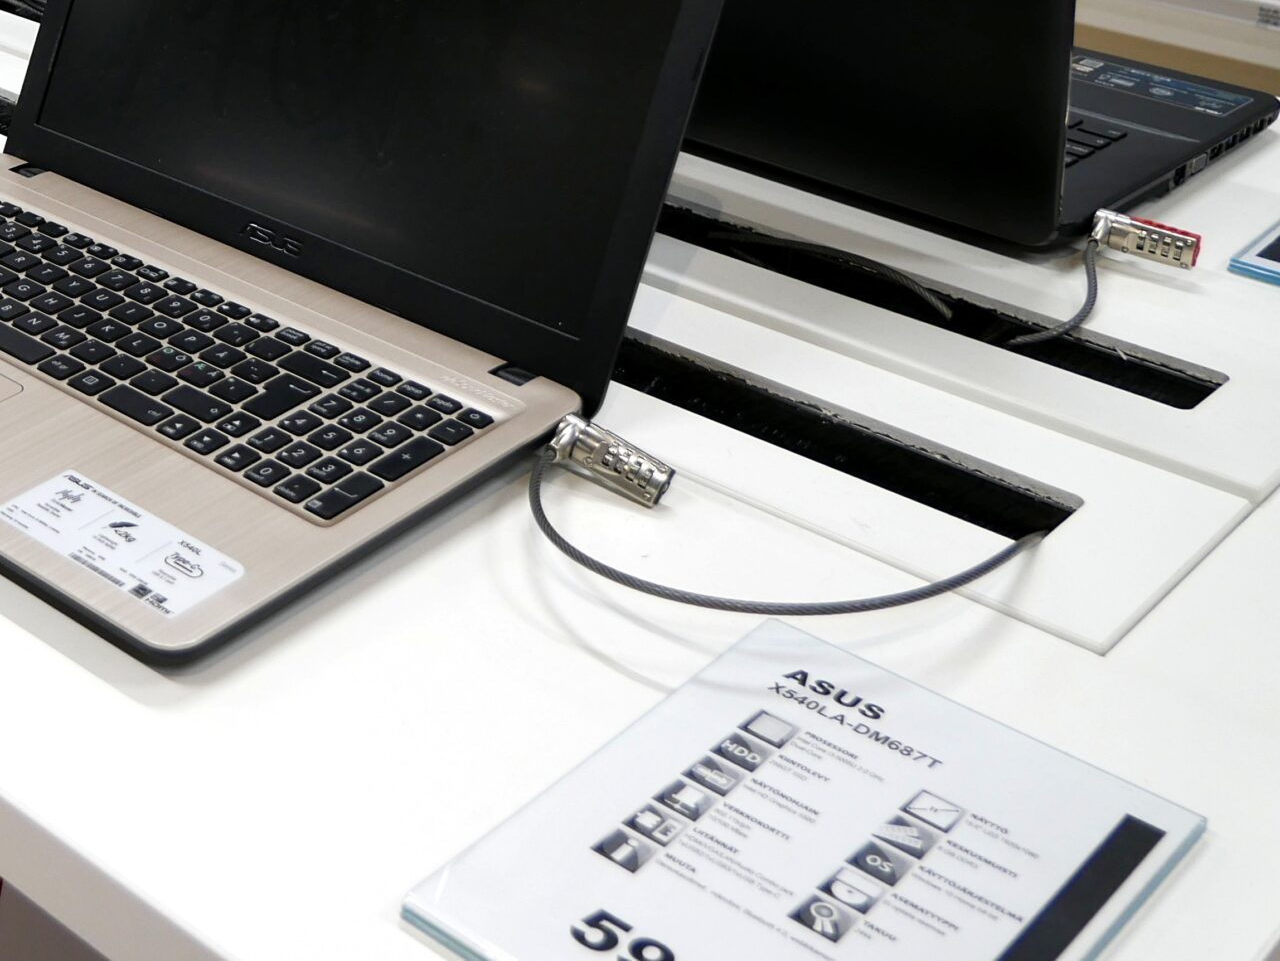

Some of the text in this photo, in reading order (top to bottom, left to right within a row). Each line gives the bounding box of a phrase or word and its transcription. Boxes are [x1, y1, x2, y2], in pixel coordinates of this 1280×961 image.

[782, 668, 886, 721] ASUS
[767, 681, 943, 769] X540LA-DM687T
[721, 739, 761, 764] HDD
[804, 730, 859, 760] PROSESSORI
[777, 754, 831, 783] KIINTOLEVY
[664, 852, 696, 874] MUUTA
[865, 854, 894, 873] OS
